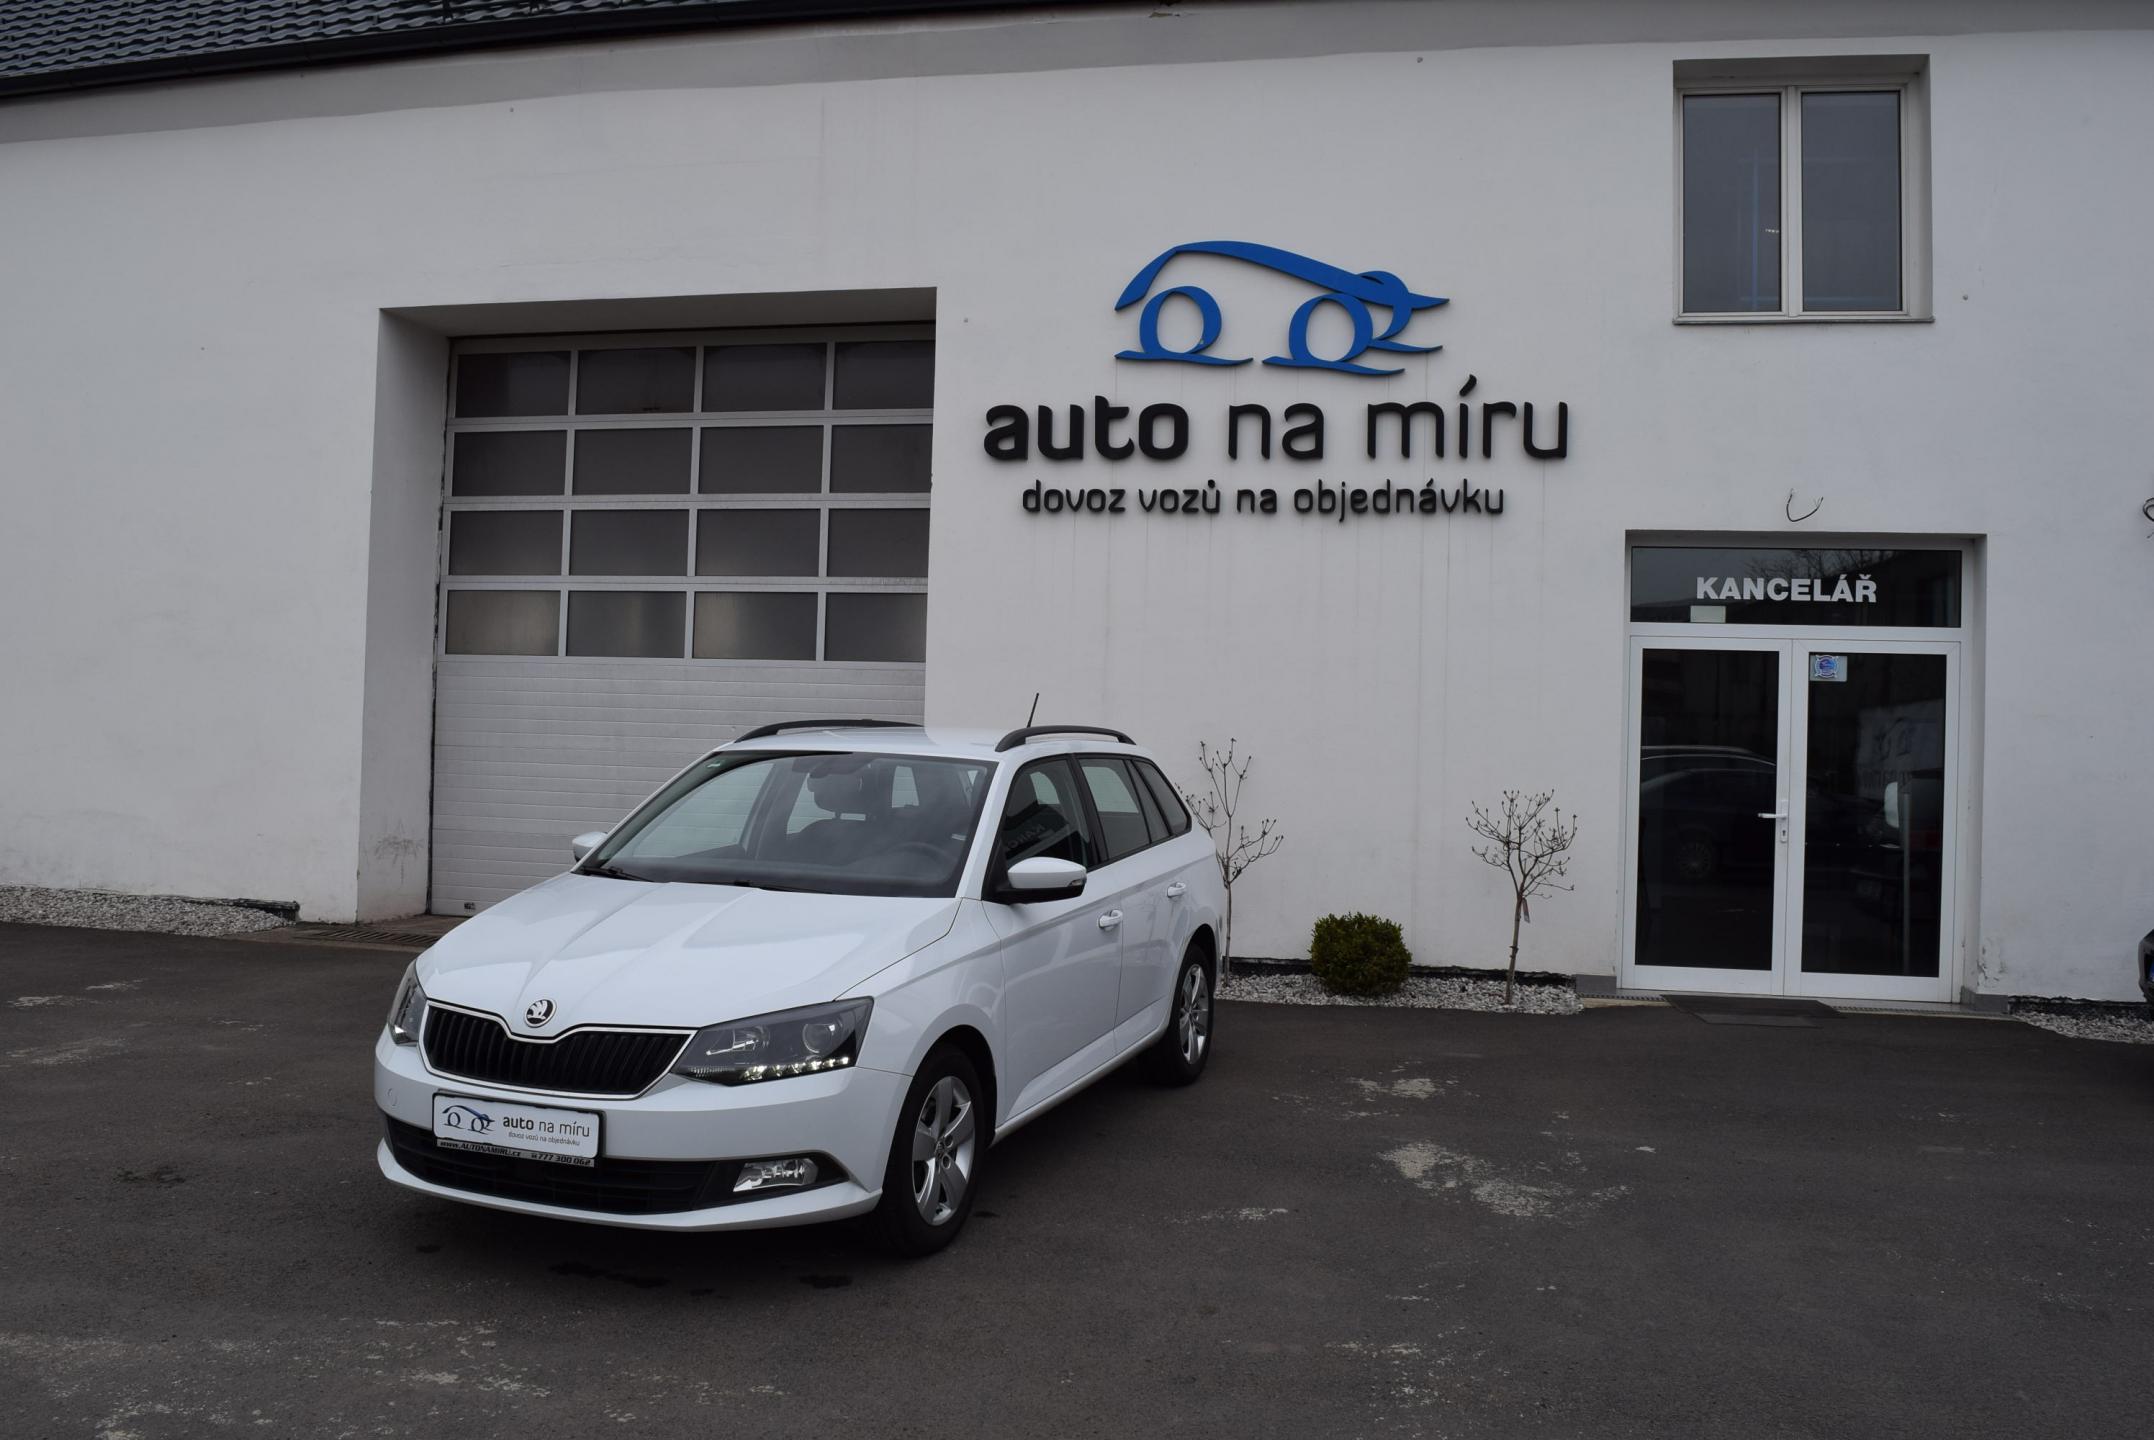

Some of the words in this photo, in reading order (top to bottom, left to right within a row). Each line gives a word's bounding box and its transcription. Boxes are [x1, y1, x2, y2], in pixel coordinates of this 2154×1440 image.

[984, 395, 1189, 461] auto
[1228, 402, 1325, 460] na
[1367, 374, 1569, 460] míru
[1022, 479, 1126, 514] dovoz
[1138, 479, 1222, 514] vozů
[1237, 488, 1278, 514] na
[1293, 477, 1505, 523] objednávku
[1696, 573, 1877, 603] KANCELÁŘ
[503, 1116, 534, 1131] auto
[539, 1121, 554, 1133] na
[559, 1120, 590, 1137] míru
